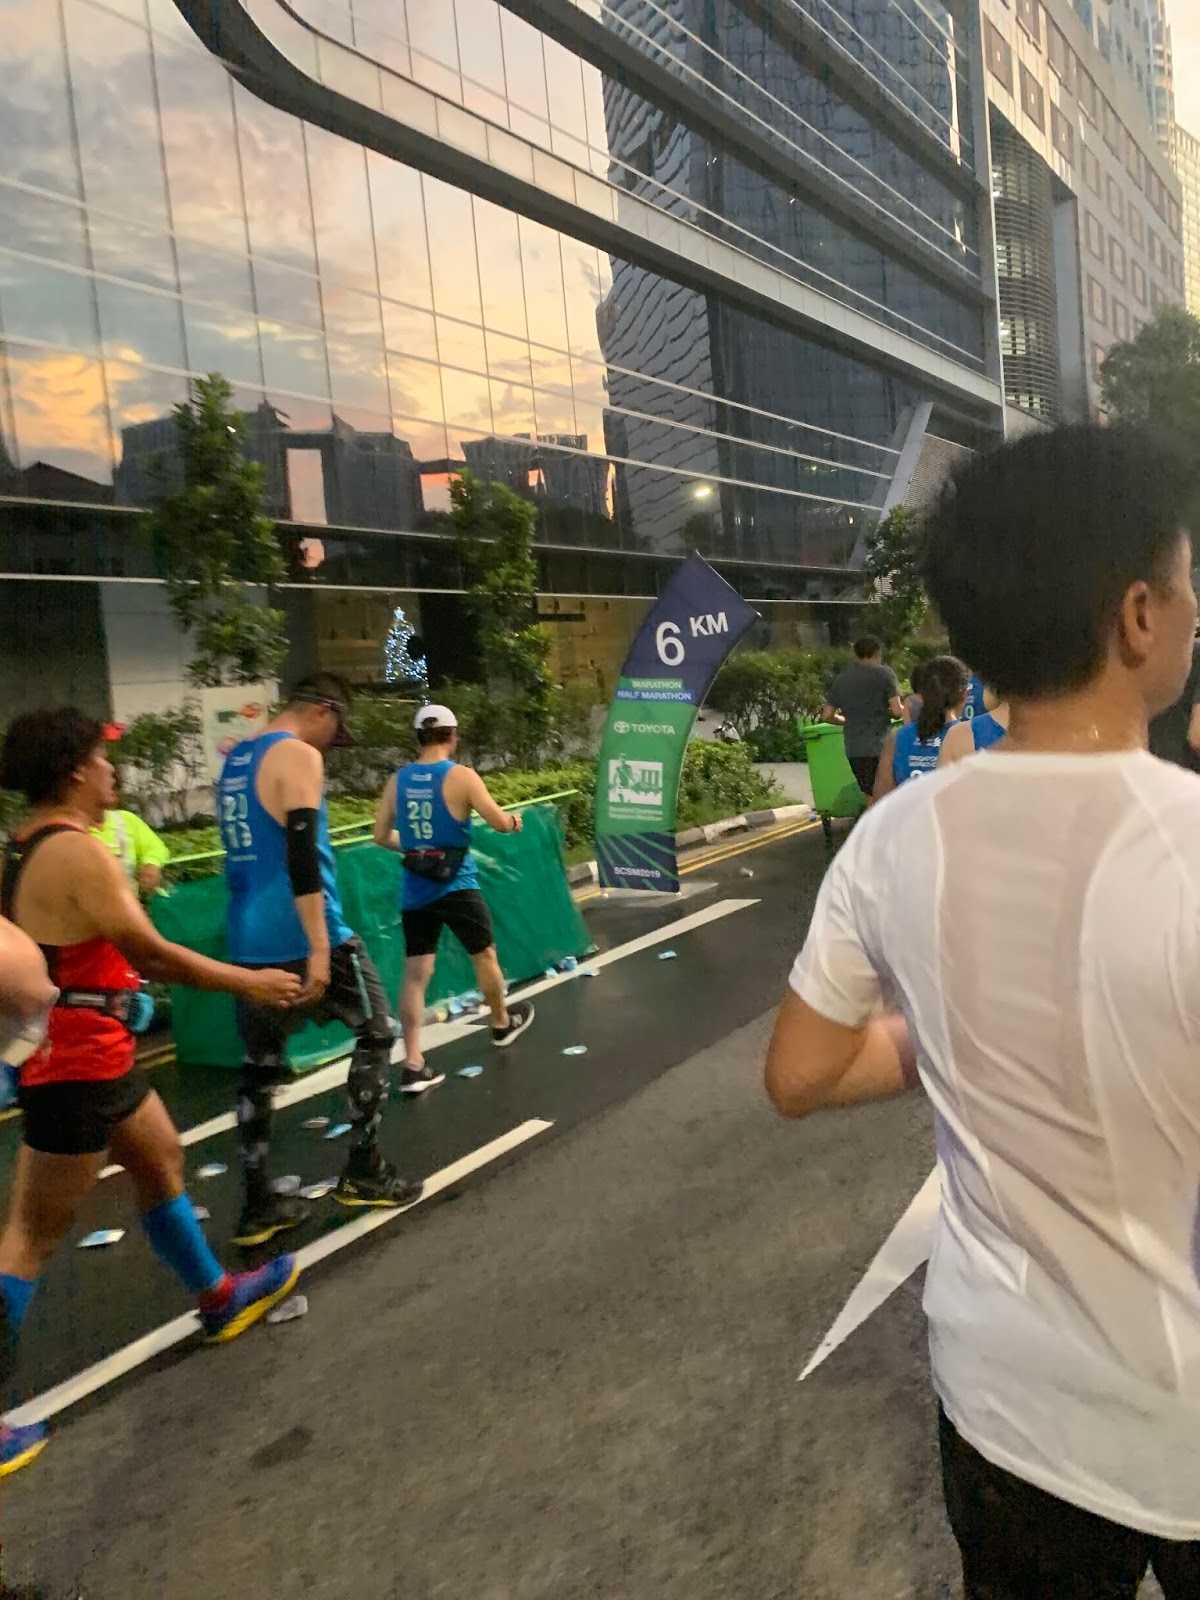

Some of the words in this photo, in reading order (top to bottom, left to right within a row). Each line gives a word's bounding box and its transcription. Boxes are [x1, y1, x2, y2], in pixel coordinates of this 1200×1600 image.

[656, 621, 685, 666] 6
[690, 612, 729, 637] KM
[631, 680, 682, 689] MARATHON
[617, 690, 640, 699] HALF
[641, 691, 692, 700] MARATHON
[631, 723, 676, 735] TOYOTA
[407, 800, 433, 820] 20
[409, 821, 434, 840] 19
[613, 866, 661, 878] SCSM2019
